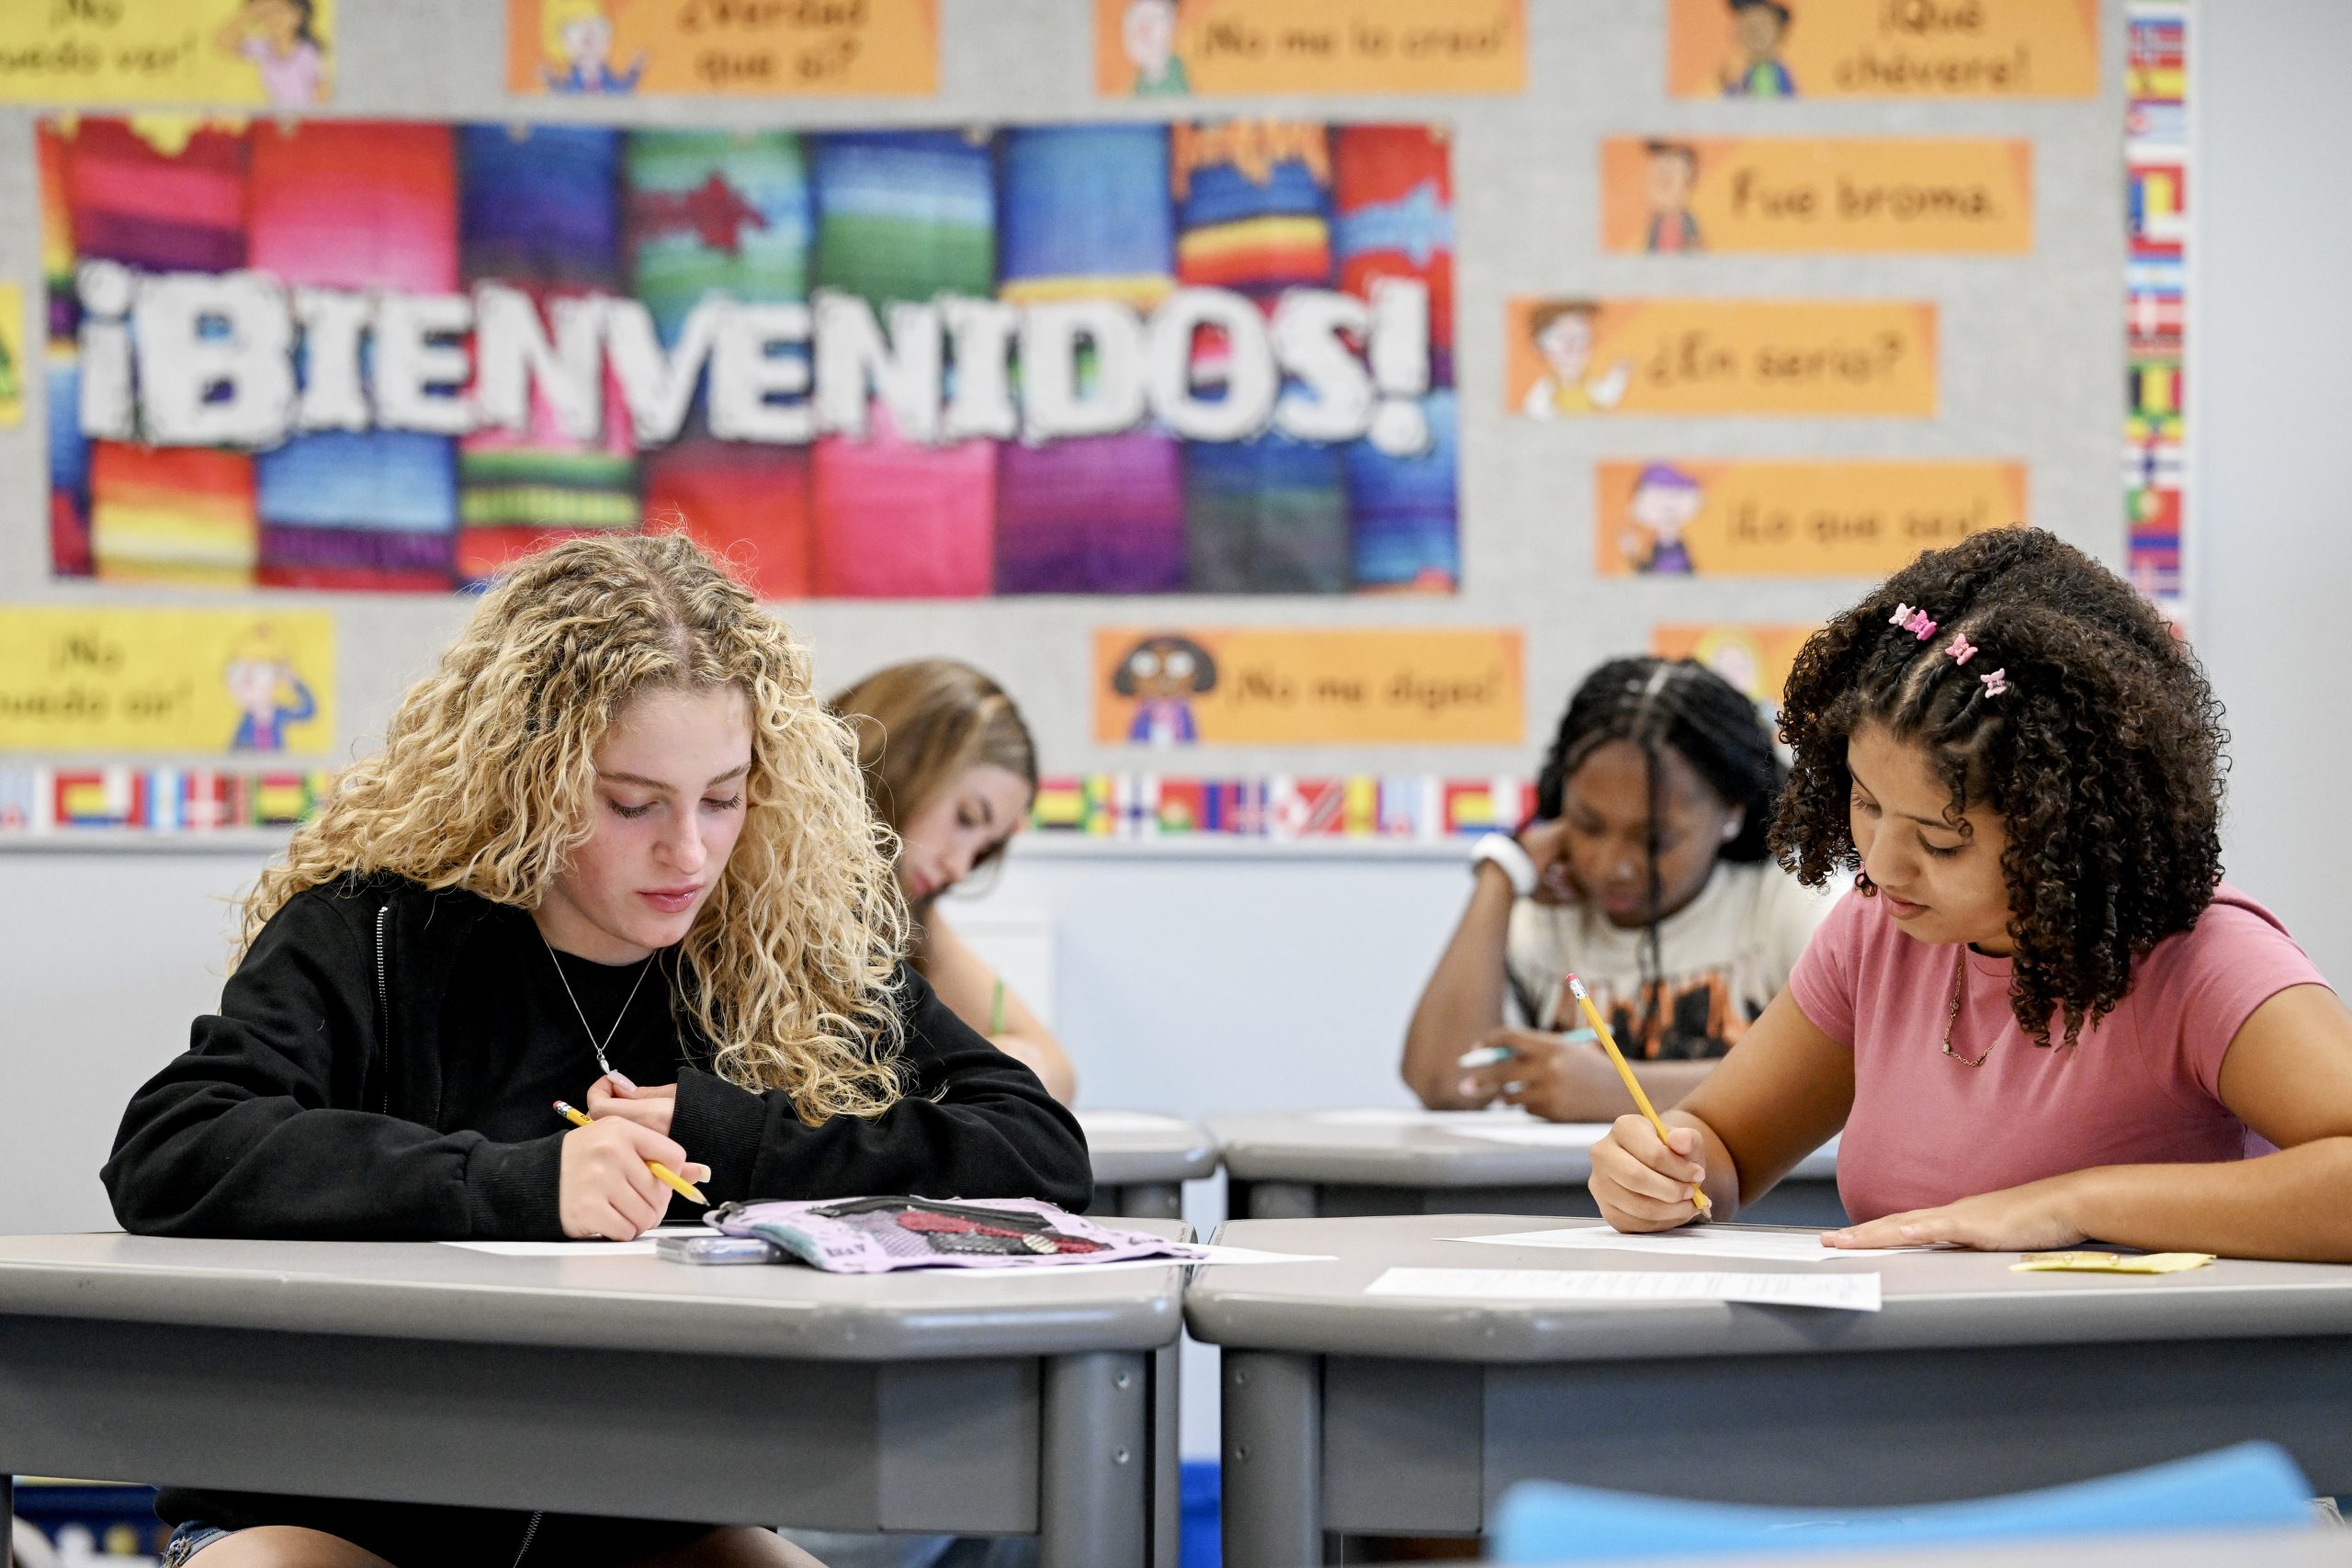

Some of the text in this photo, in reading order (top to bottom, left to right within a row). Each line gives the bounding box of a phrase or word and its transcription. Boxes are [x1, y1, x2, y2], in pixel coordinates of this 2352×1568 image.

[1275, 27, 1340, 61] me
[1349, 14, 1394, 61] lo
[694, 51, 781, 90] que
[1730, 164, 1822, 220] Fue
[79, 259, 1430, 457] ¡BIENVENIDOS!
[1645, 328, 1907, 389] ¿En serio?
[1803, 509, 1885, 547] que
[1309, 673, 1373, 708] me
